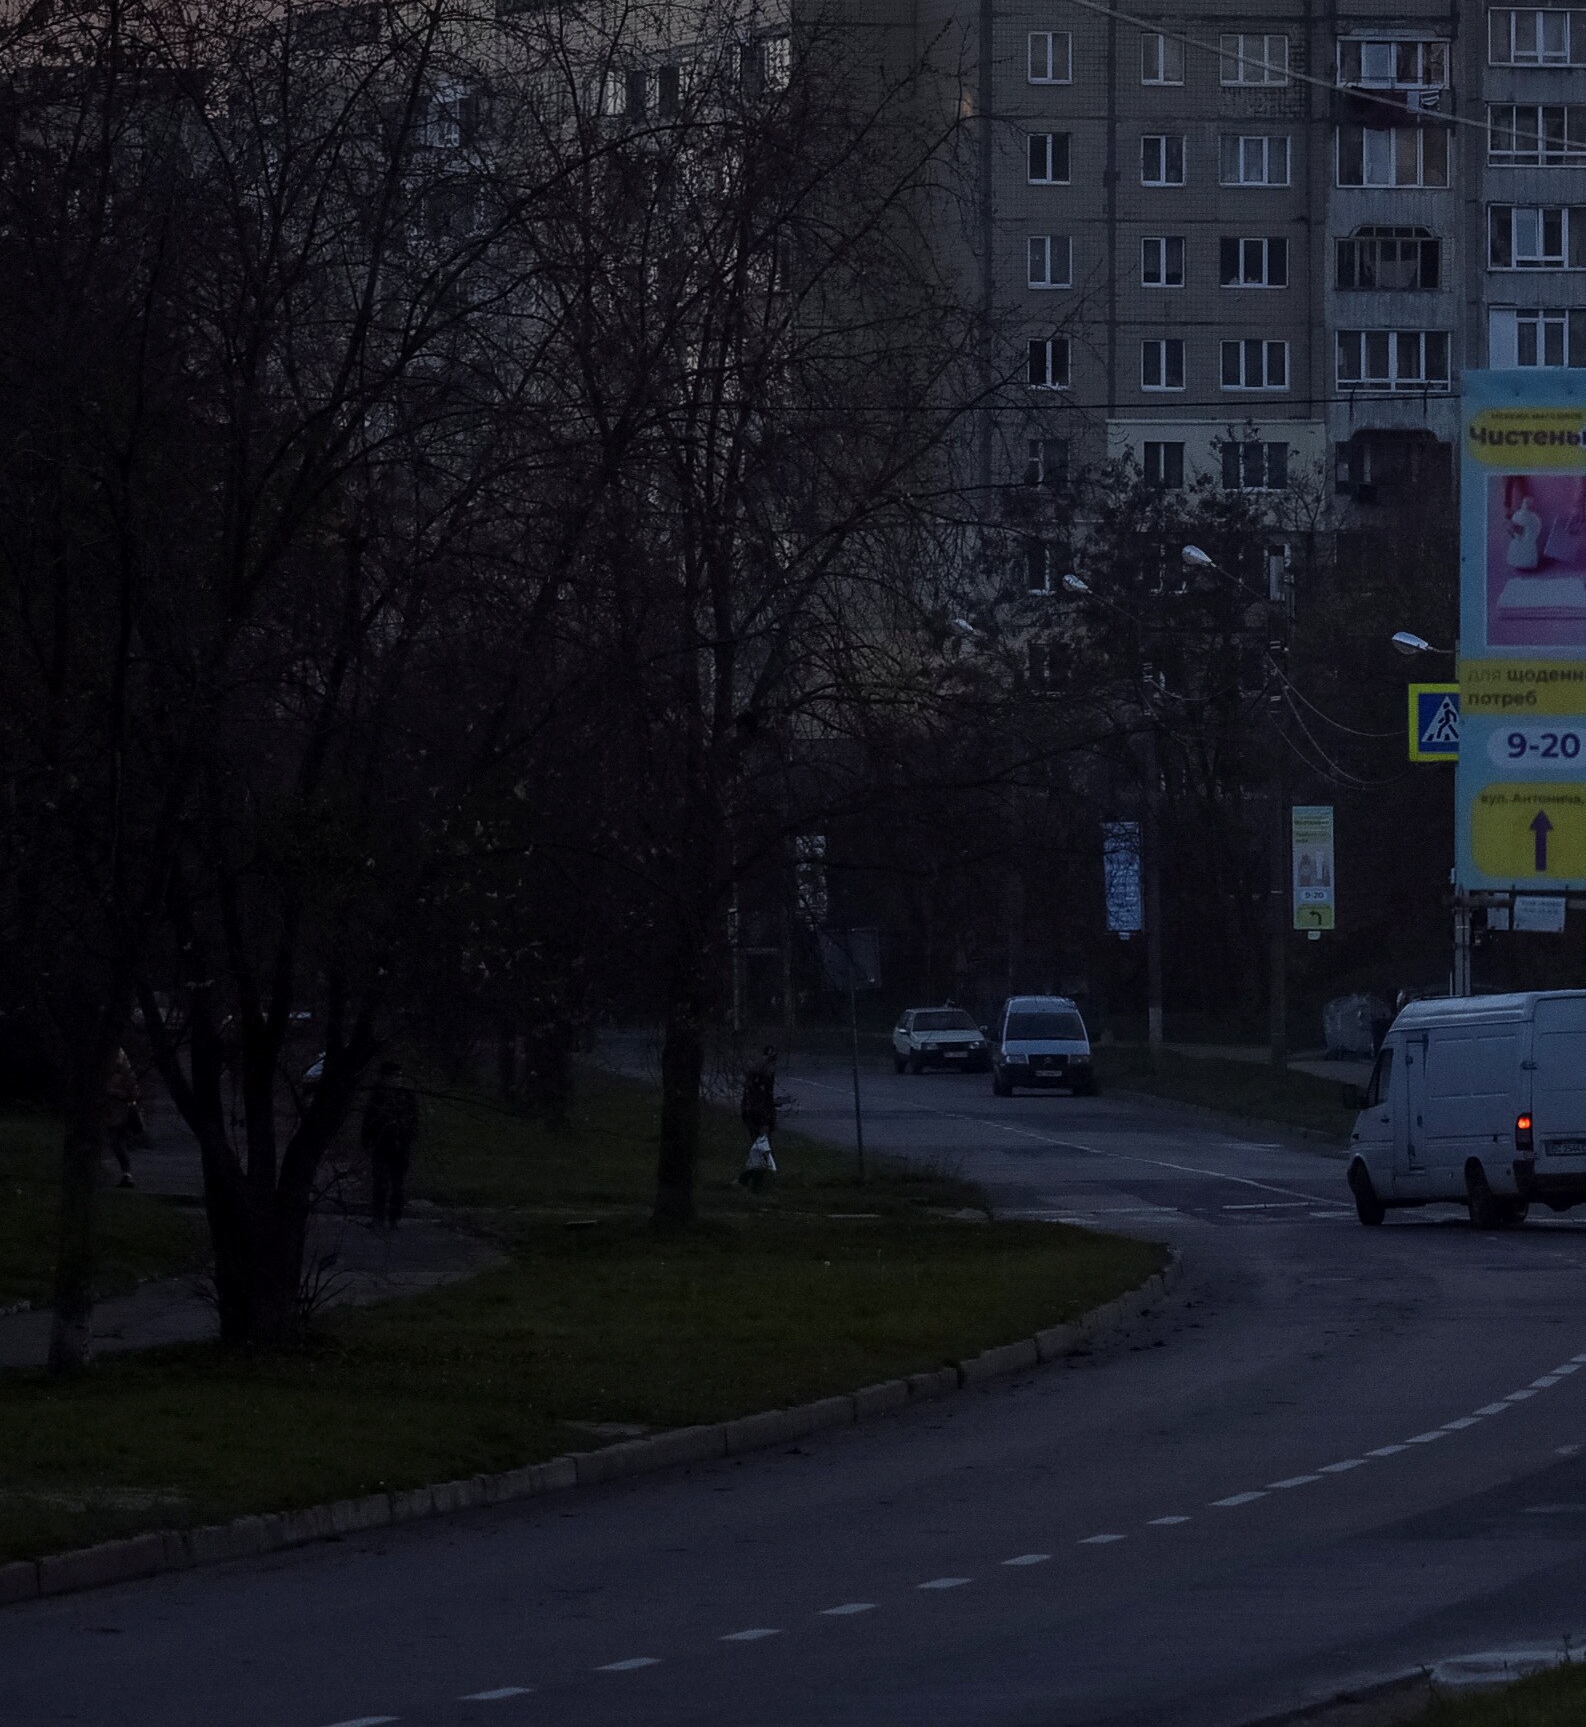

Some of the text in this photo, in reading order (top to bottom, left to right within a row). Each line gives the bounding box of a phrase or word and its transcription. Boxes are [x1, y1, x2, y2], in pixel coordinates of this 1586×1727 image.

[1468, 669, 1501, 681] для
[1468, 690, 1538, 708] потреб
[1507, 732, 1581, 759] 9-20
[1305, 891, 1325, 899] 9-20
